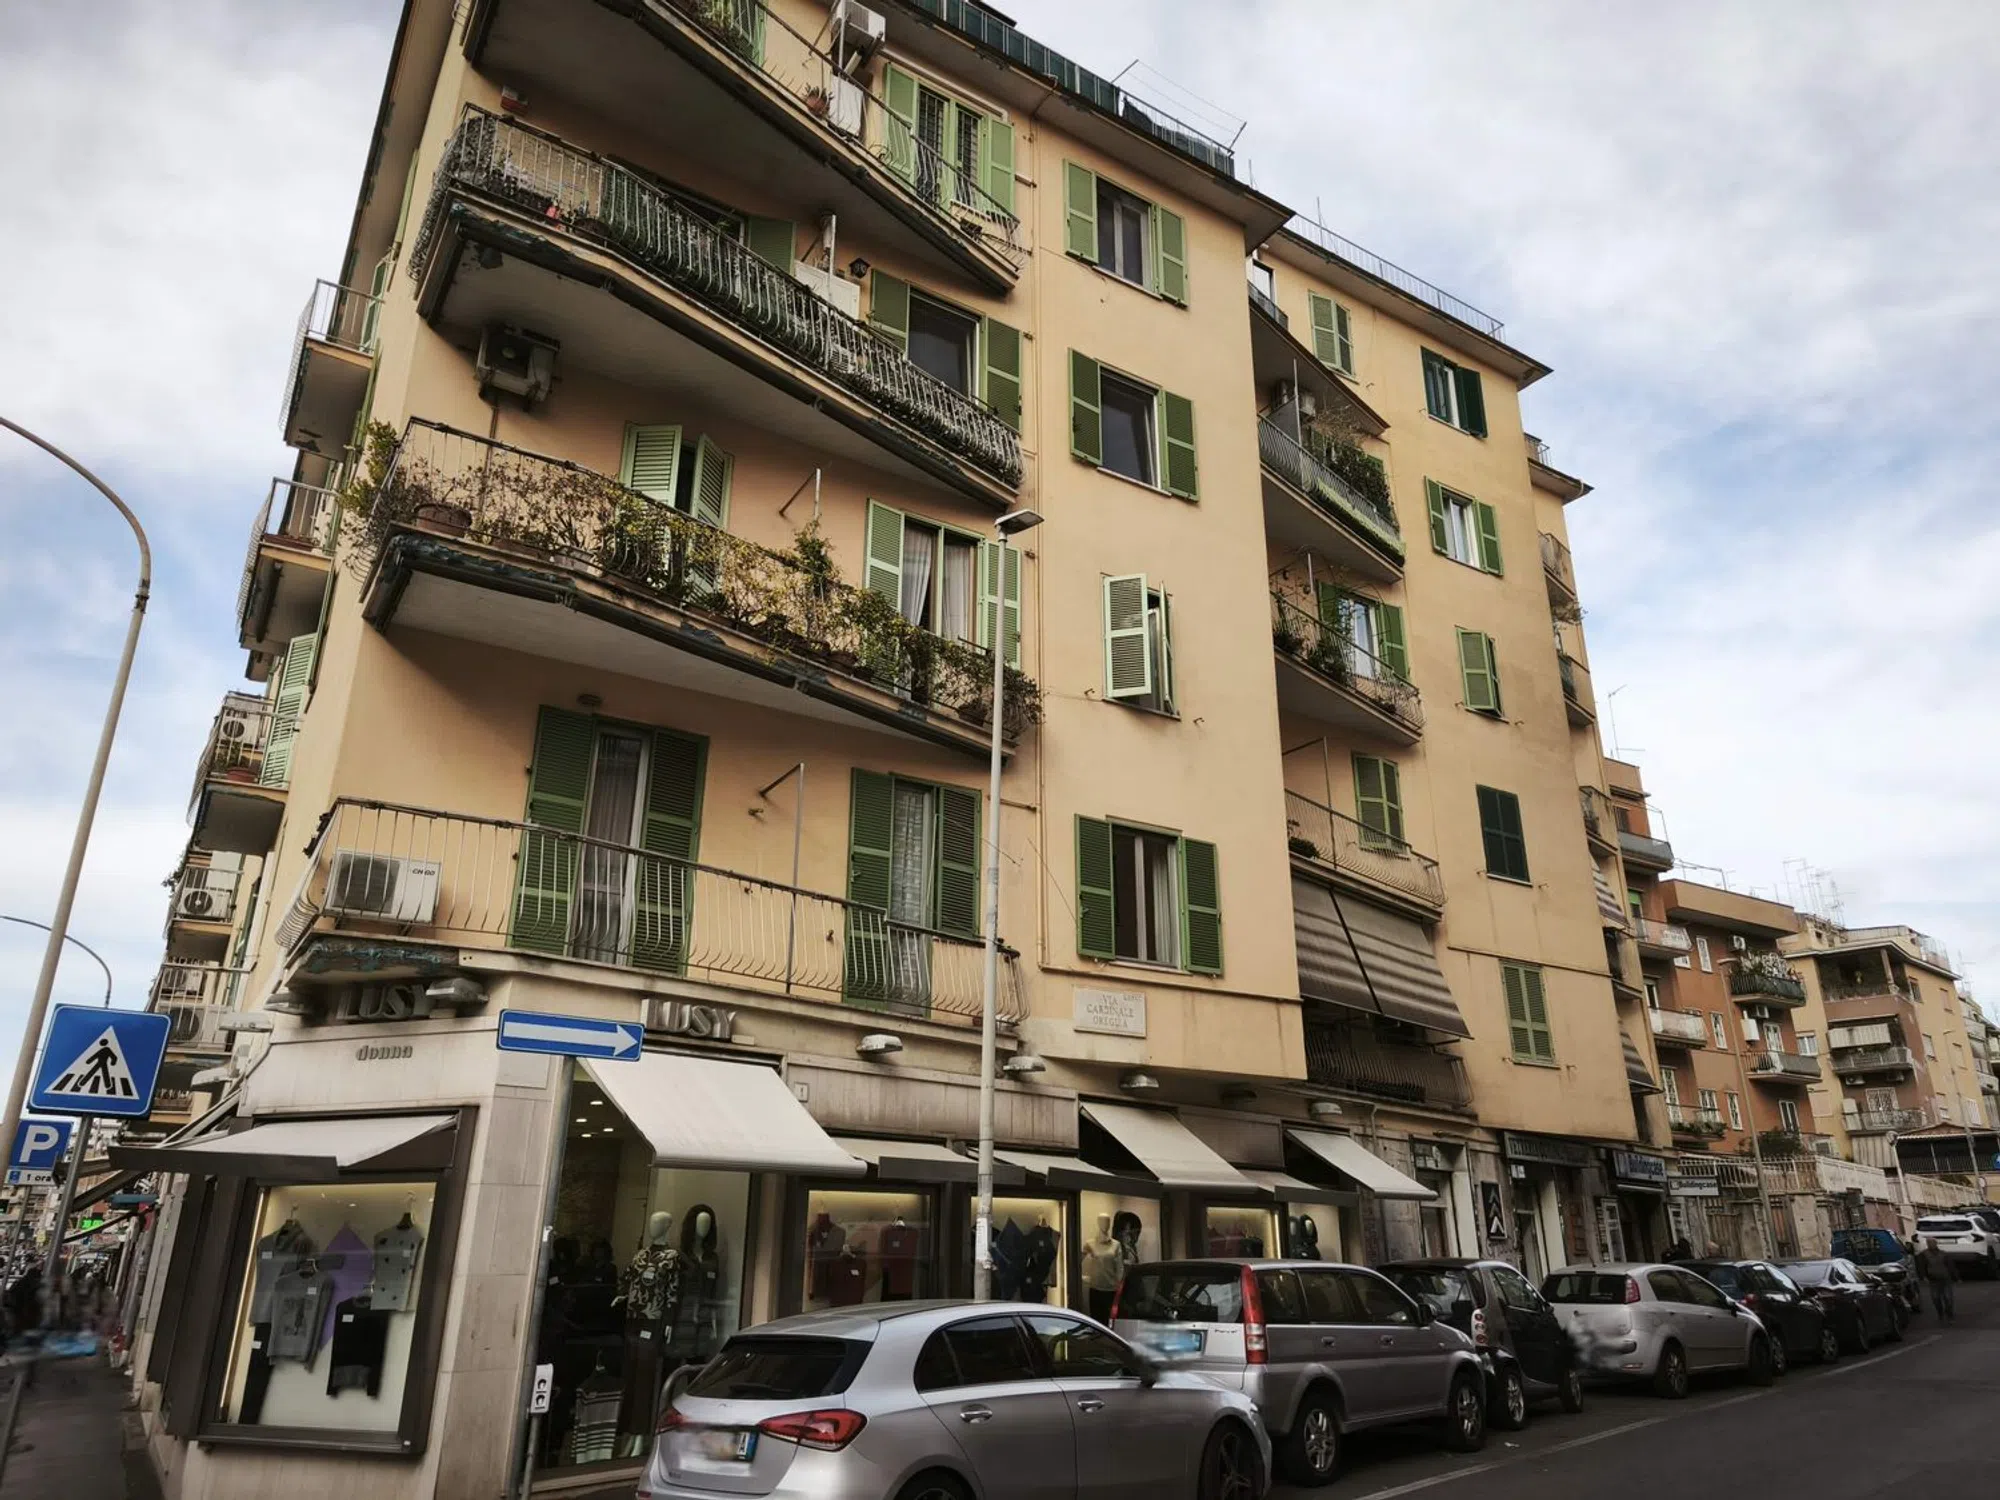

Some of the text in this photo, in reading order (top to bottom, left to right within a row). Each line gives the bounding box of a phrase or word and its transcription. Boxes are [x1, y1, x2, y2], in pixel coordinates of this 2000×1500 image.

[336, 984, 432, 1020] LUSY
[1101, 993, 1119, 1006] VIA
[640, 998, 737, 1039] LUSY
[1086, 1003, 1135, 1018] CARDINALE
[355, 1045, 413, 1061] donna
[19, 1124, 59, 1163] P
[34, 1174, 52, 1182] ora
